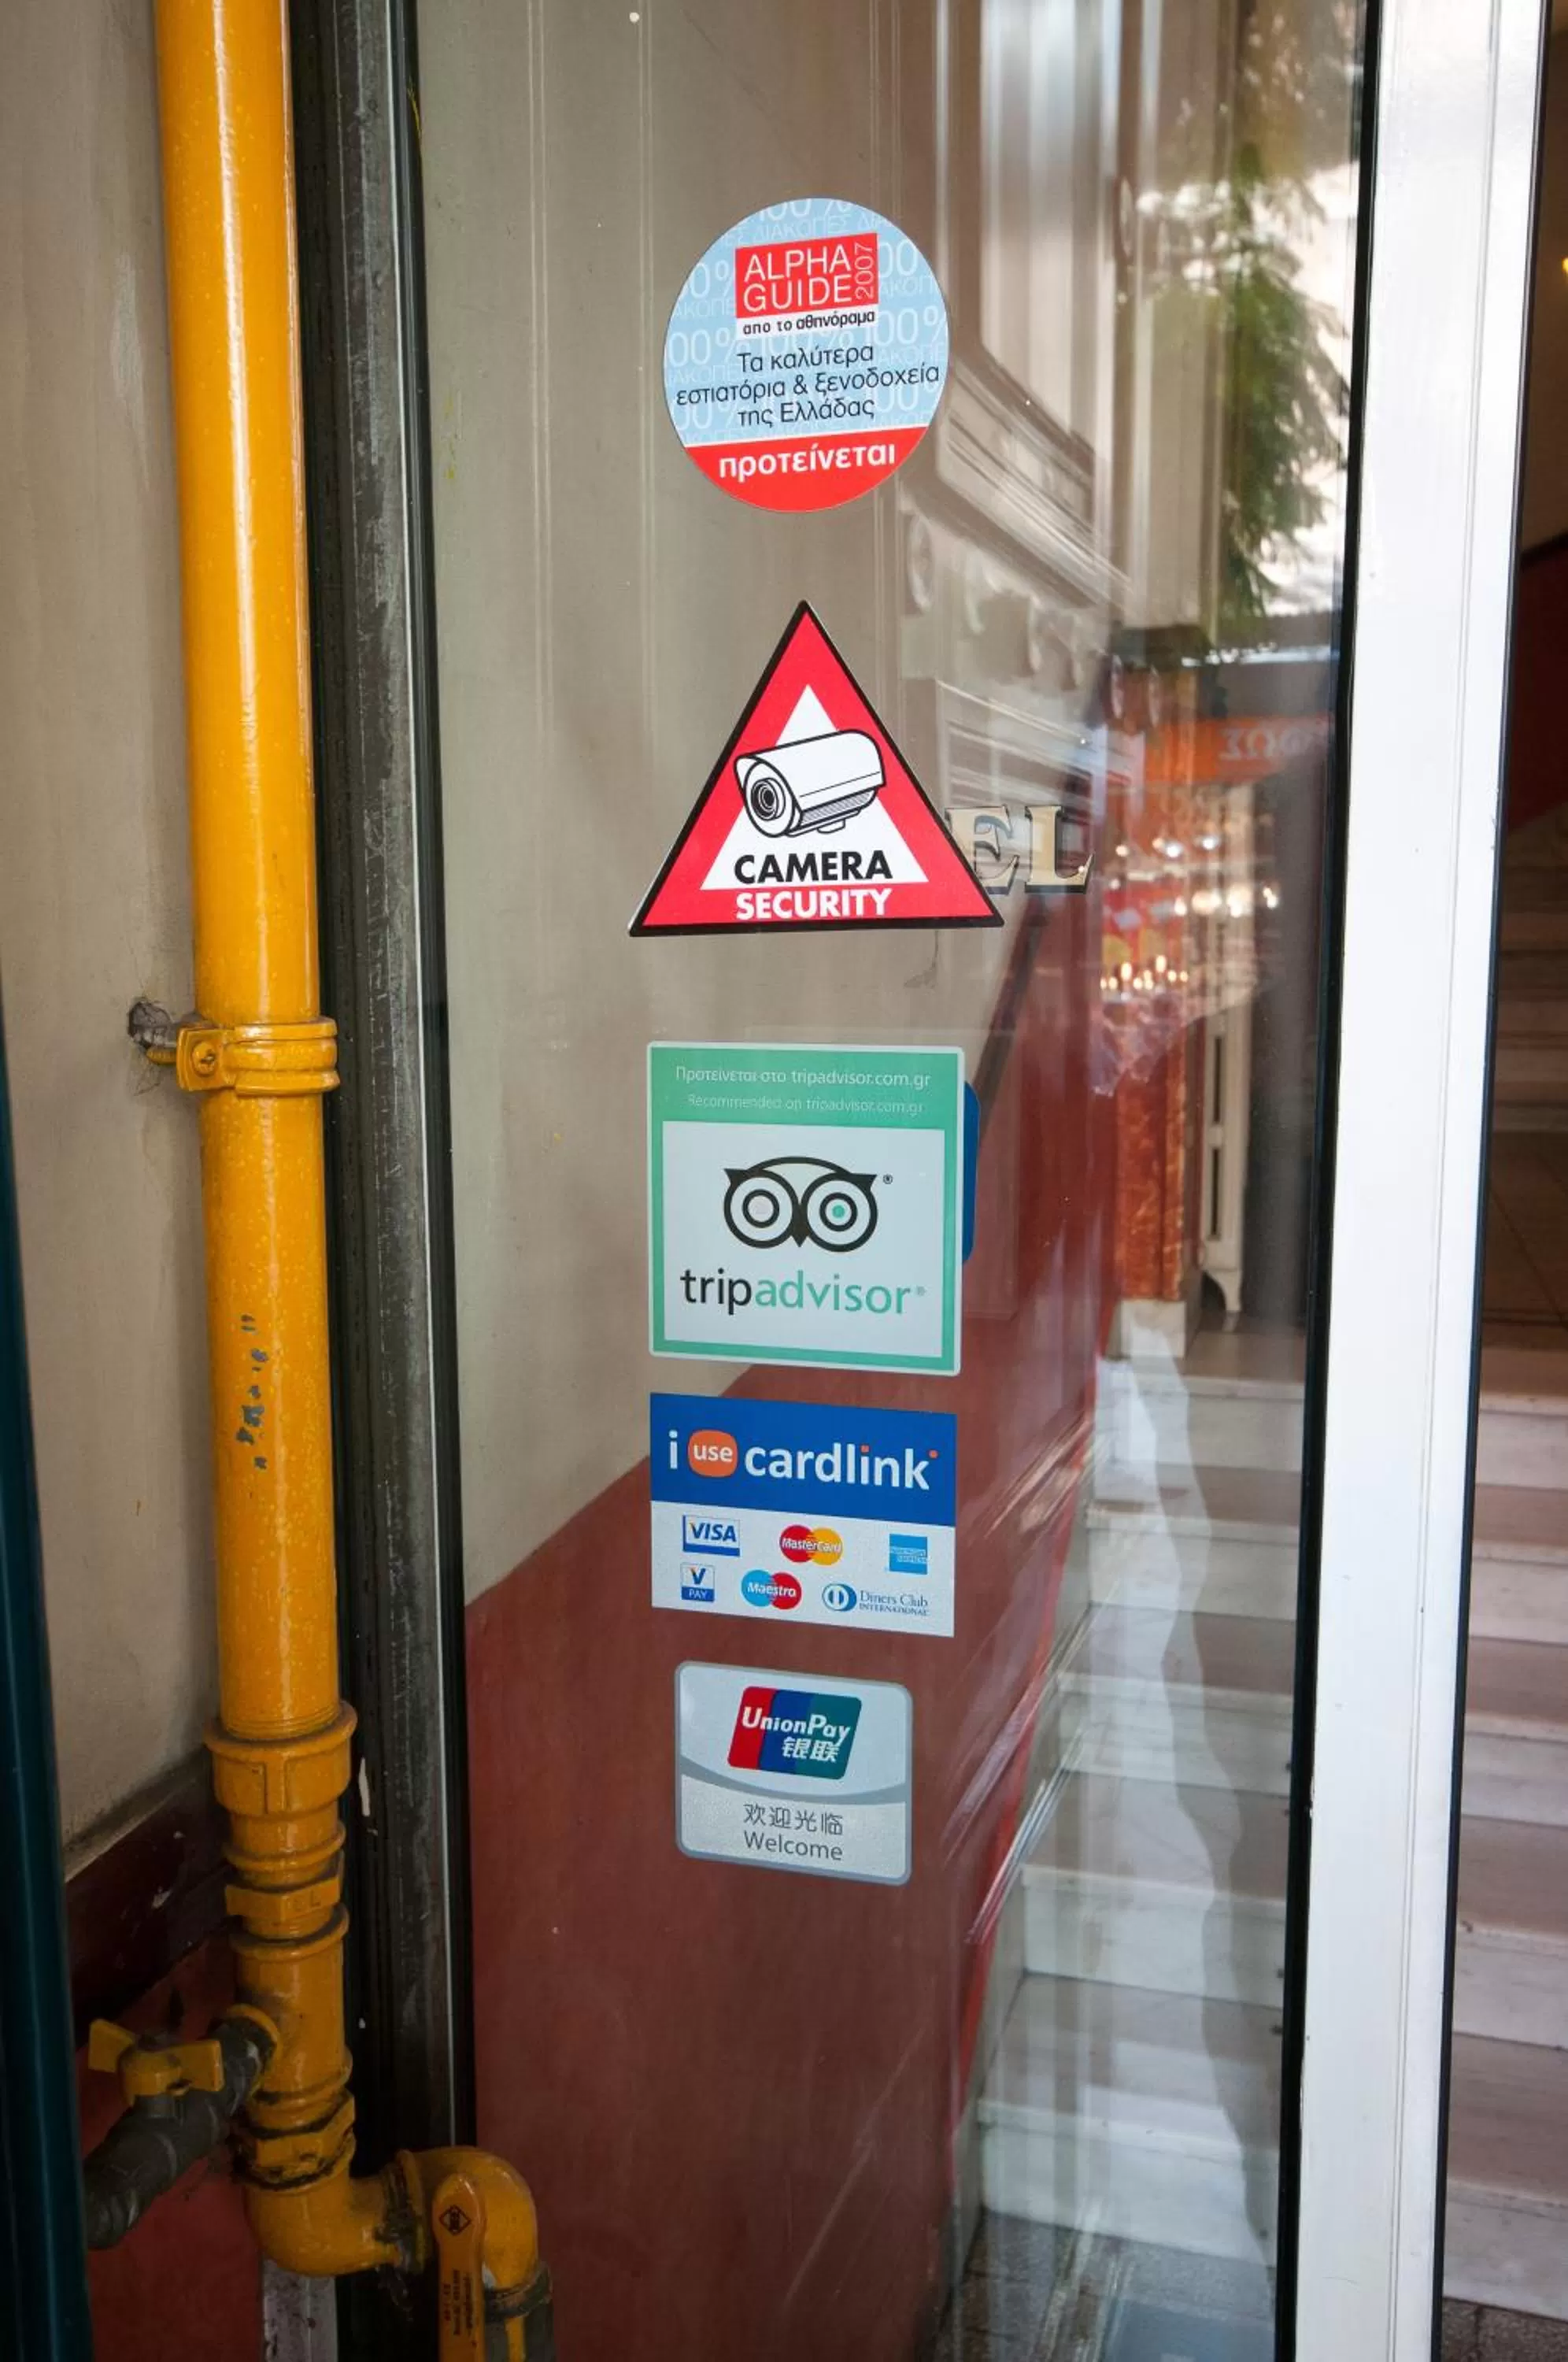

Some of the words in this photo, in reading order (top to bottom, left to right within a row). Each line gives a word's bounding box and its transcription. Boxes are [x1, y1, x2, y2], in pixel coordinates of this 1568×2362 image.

[744, 244, 852, 283] ALPHA
[854, 242, 875, 300] 2007
[743, 274, 852, 313] GUIDE
[737, 351, 763, 373] Τα
[770, 343, 874, 370] καλύτερα
[675, 379, 786, 405] εστιατόρια
[793, 374, 808, 394] &
[815, 362, 940, 397] ξενοδοχεία
[738, 409, 773, 428] της
[781, 398, 875, 424] Ελλάδας
[719, 442, 896, 483] προτείνεται
[734, 850, 893, 884] CAMERA
[735, 888, 893, 920] SECURITY
[790, 1068, 931, 1090] tripadvisor.com.gr
[668, 1430, 679, 1470] i
[693, 1443, 734, 1464] use
[745, 1442, 930, 1490] cardlink
[690, 1521, 737, 1542] VISA
[689, 1589, 708, 1599] PAY
[747, 1581, 797, 1598] Maestro
[860, 1590, 897, 1605] Diners
[900, 1593, 928, 1607] Club
[741, 1706, 850, 1746] UnionPay
[782, 1737, 840, 1763] 银联
[743, 1804, 843, 1836] 欢迎光临
[744, 1831, 843, 1860] Welcome
